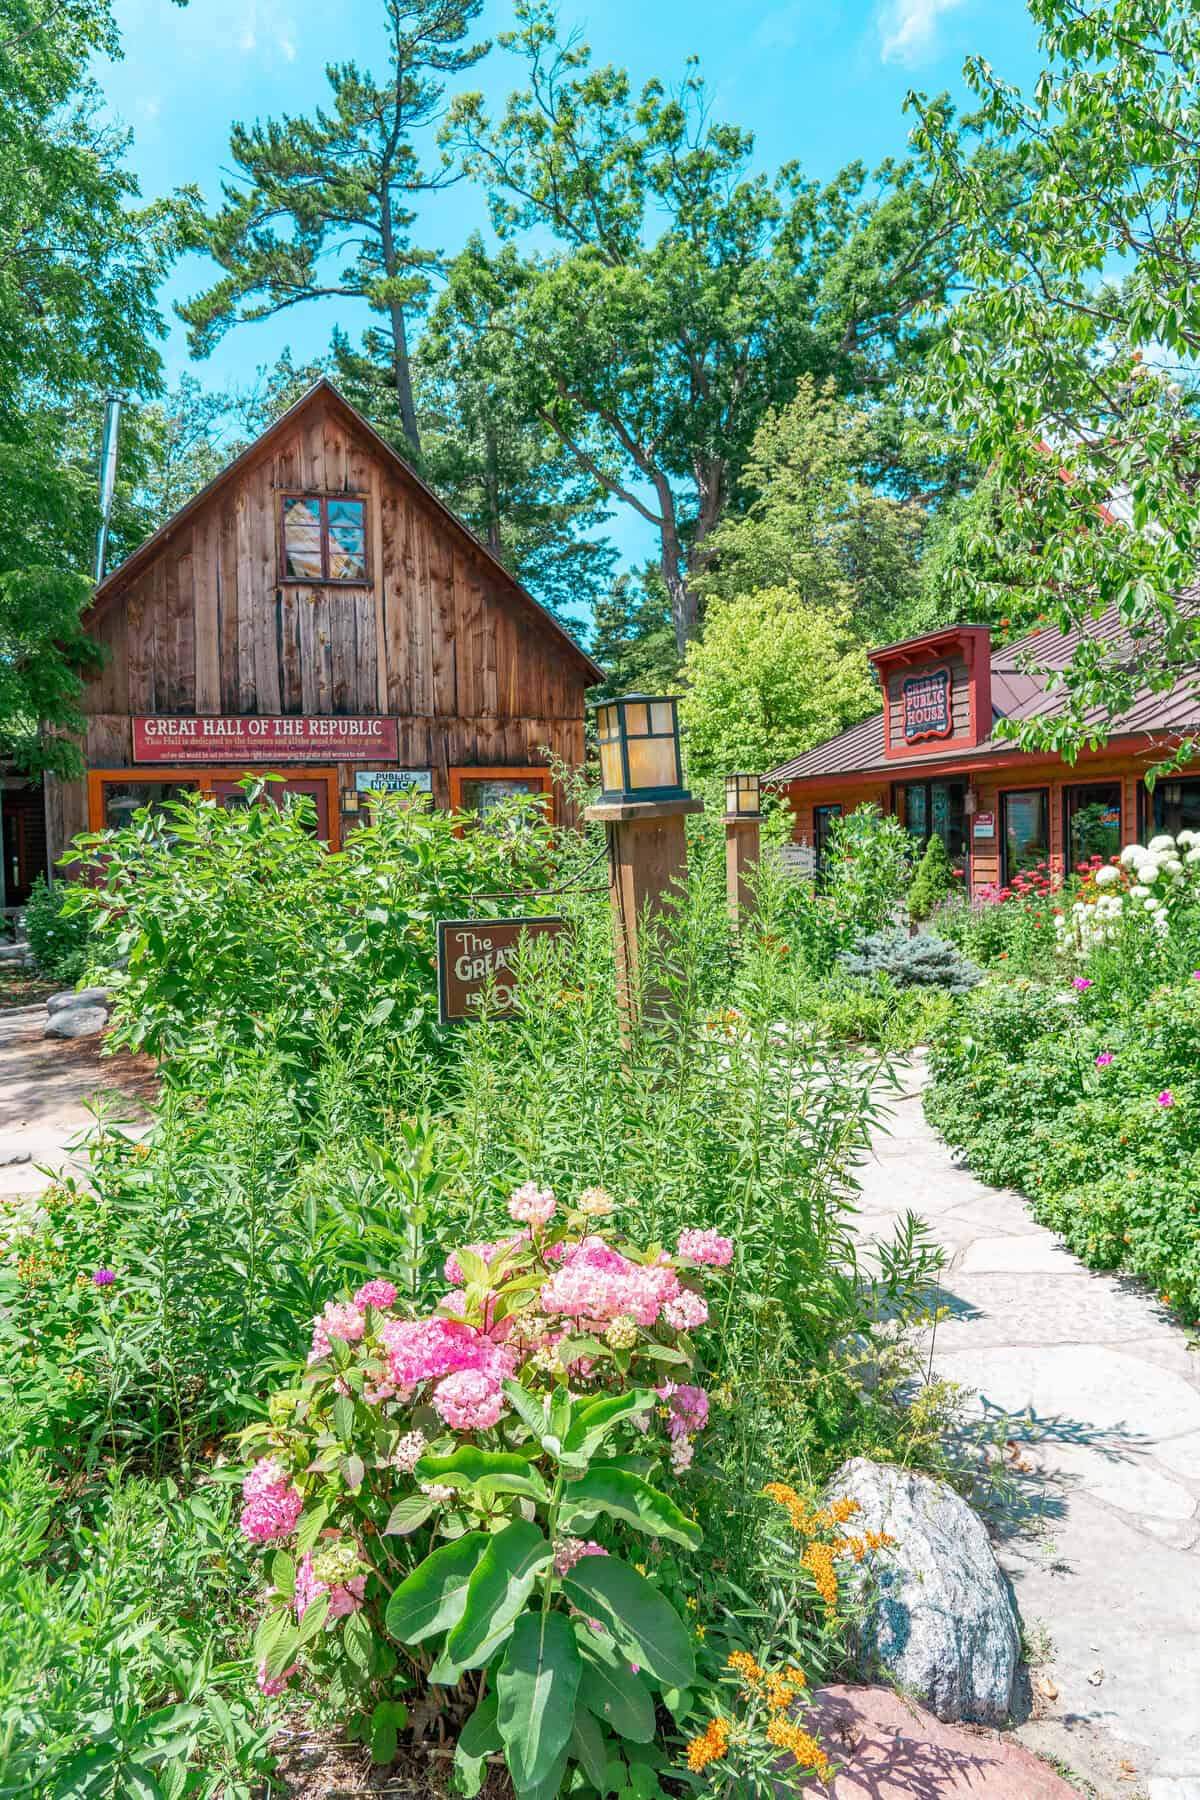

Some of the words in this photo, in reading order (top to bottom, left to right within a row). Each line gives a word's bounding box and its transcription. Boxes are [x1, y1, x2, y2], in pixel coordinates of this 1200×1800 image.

[906, 678, 945, 697] CHERRY
[906, 689, 945, 711] PUBLIC
[907, 704, 945, 725] HOUSE
[144, 719, 197, 736] GREAT
[202, 719, 245, 736] HALL
[248, 719, 269, 736] OF
[272, 719, 304, 736] THE
[308, 719, 383, 736] REPUBLIC
[373, 780, 413, 790] NOTIC
[376, 773, 411, 781] PUBLIC
[455, 932, 494, 955] The
[454, 948, 519, 981] GREAT
